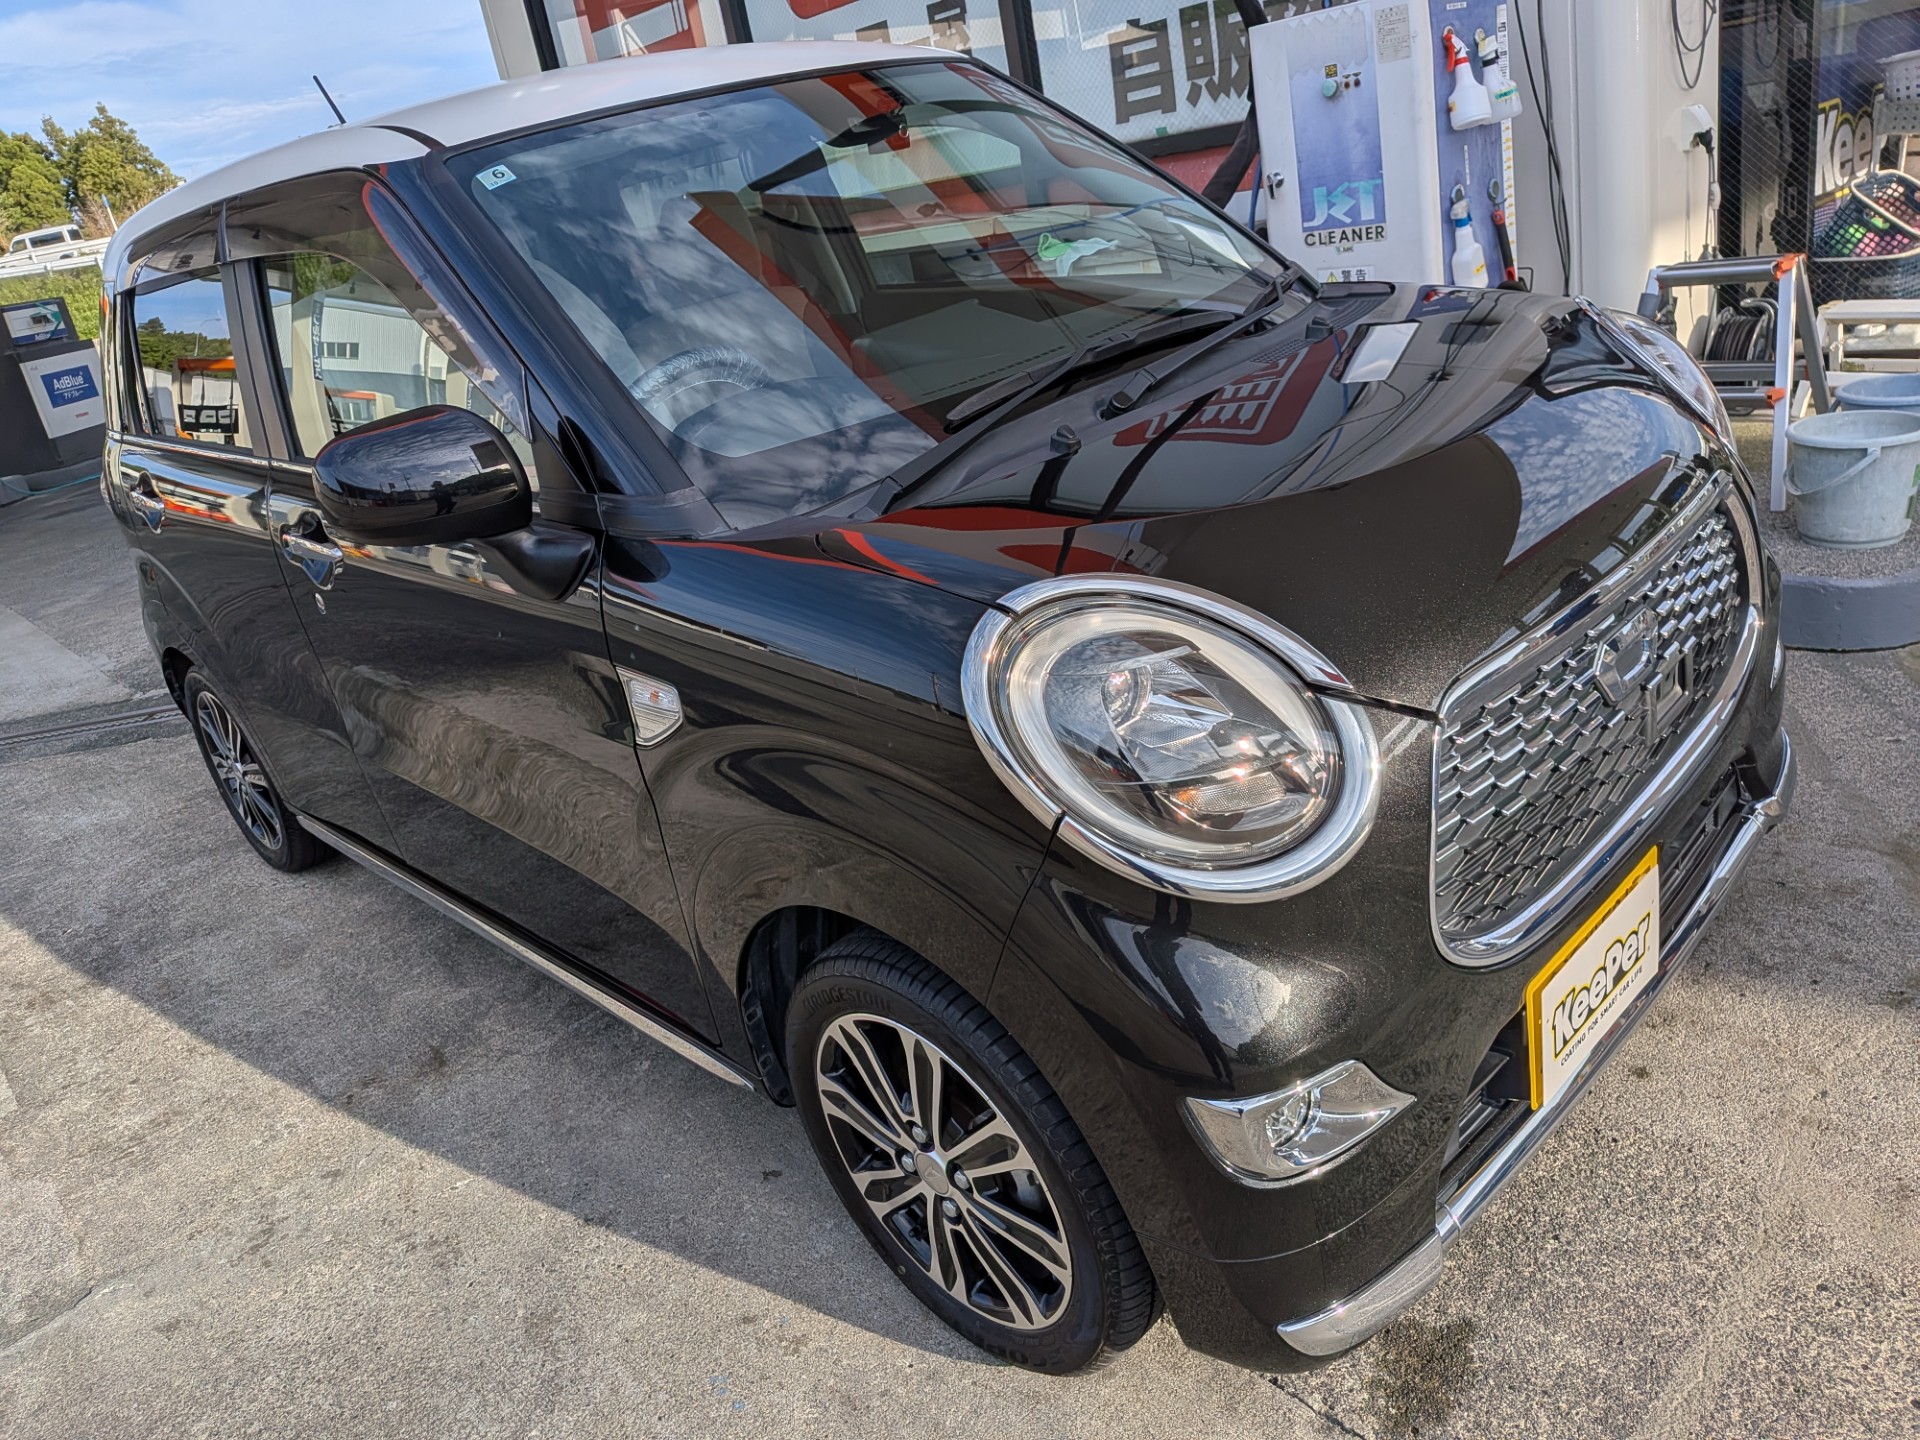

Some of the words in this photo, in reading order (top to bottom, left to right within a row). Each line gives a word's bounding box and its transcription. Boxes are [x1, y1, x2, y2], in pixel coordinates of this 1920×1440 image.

[1108, 0, 1300, 125] 自販
[492, 168, 505, 179] 6
[1815, 98, 1880, 197] Kee
[1304, 225, 1385, 247] CLEANER
[1340, 268, 1367, 283] 警告
[53, 373, 84, 390] AdBlue
[1552, 911, 1651, 1059] KeePer
[1560, 1032, 1587, 1067] COATING
[1587, 1016, 1599, 1036] FOR
[1599, 993, 1619, 1021] SMART
[1618, 980, 1631, 998] CAR
[1630, 964, 1643, 984] LIFE
